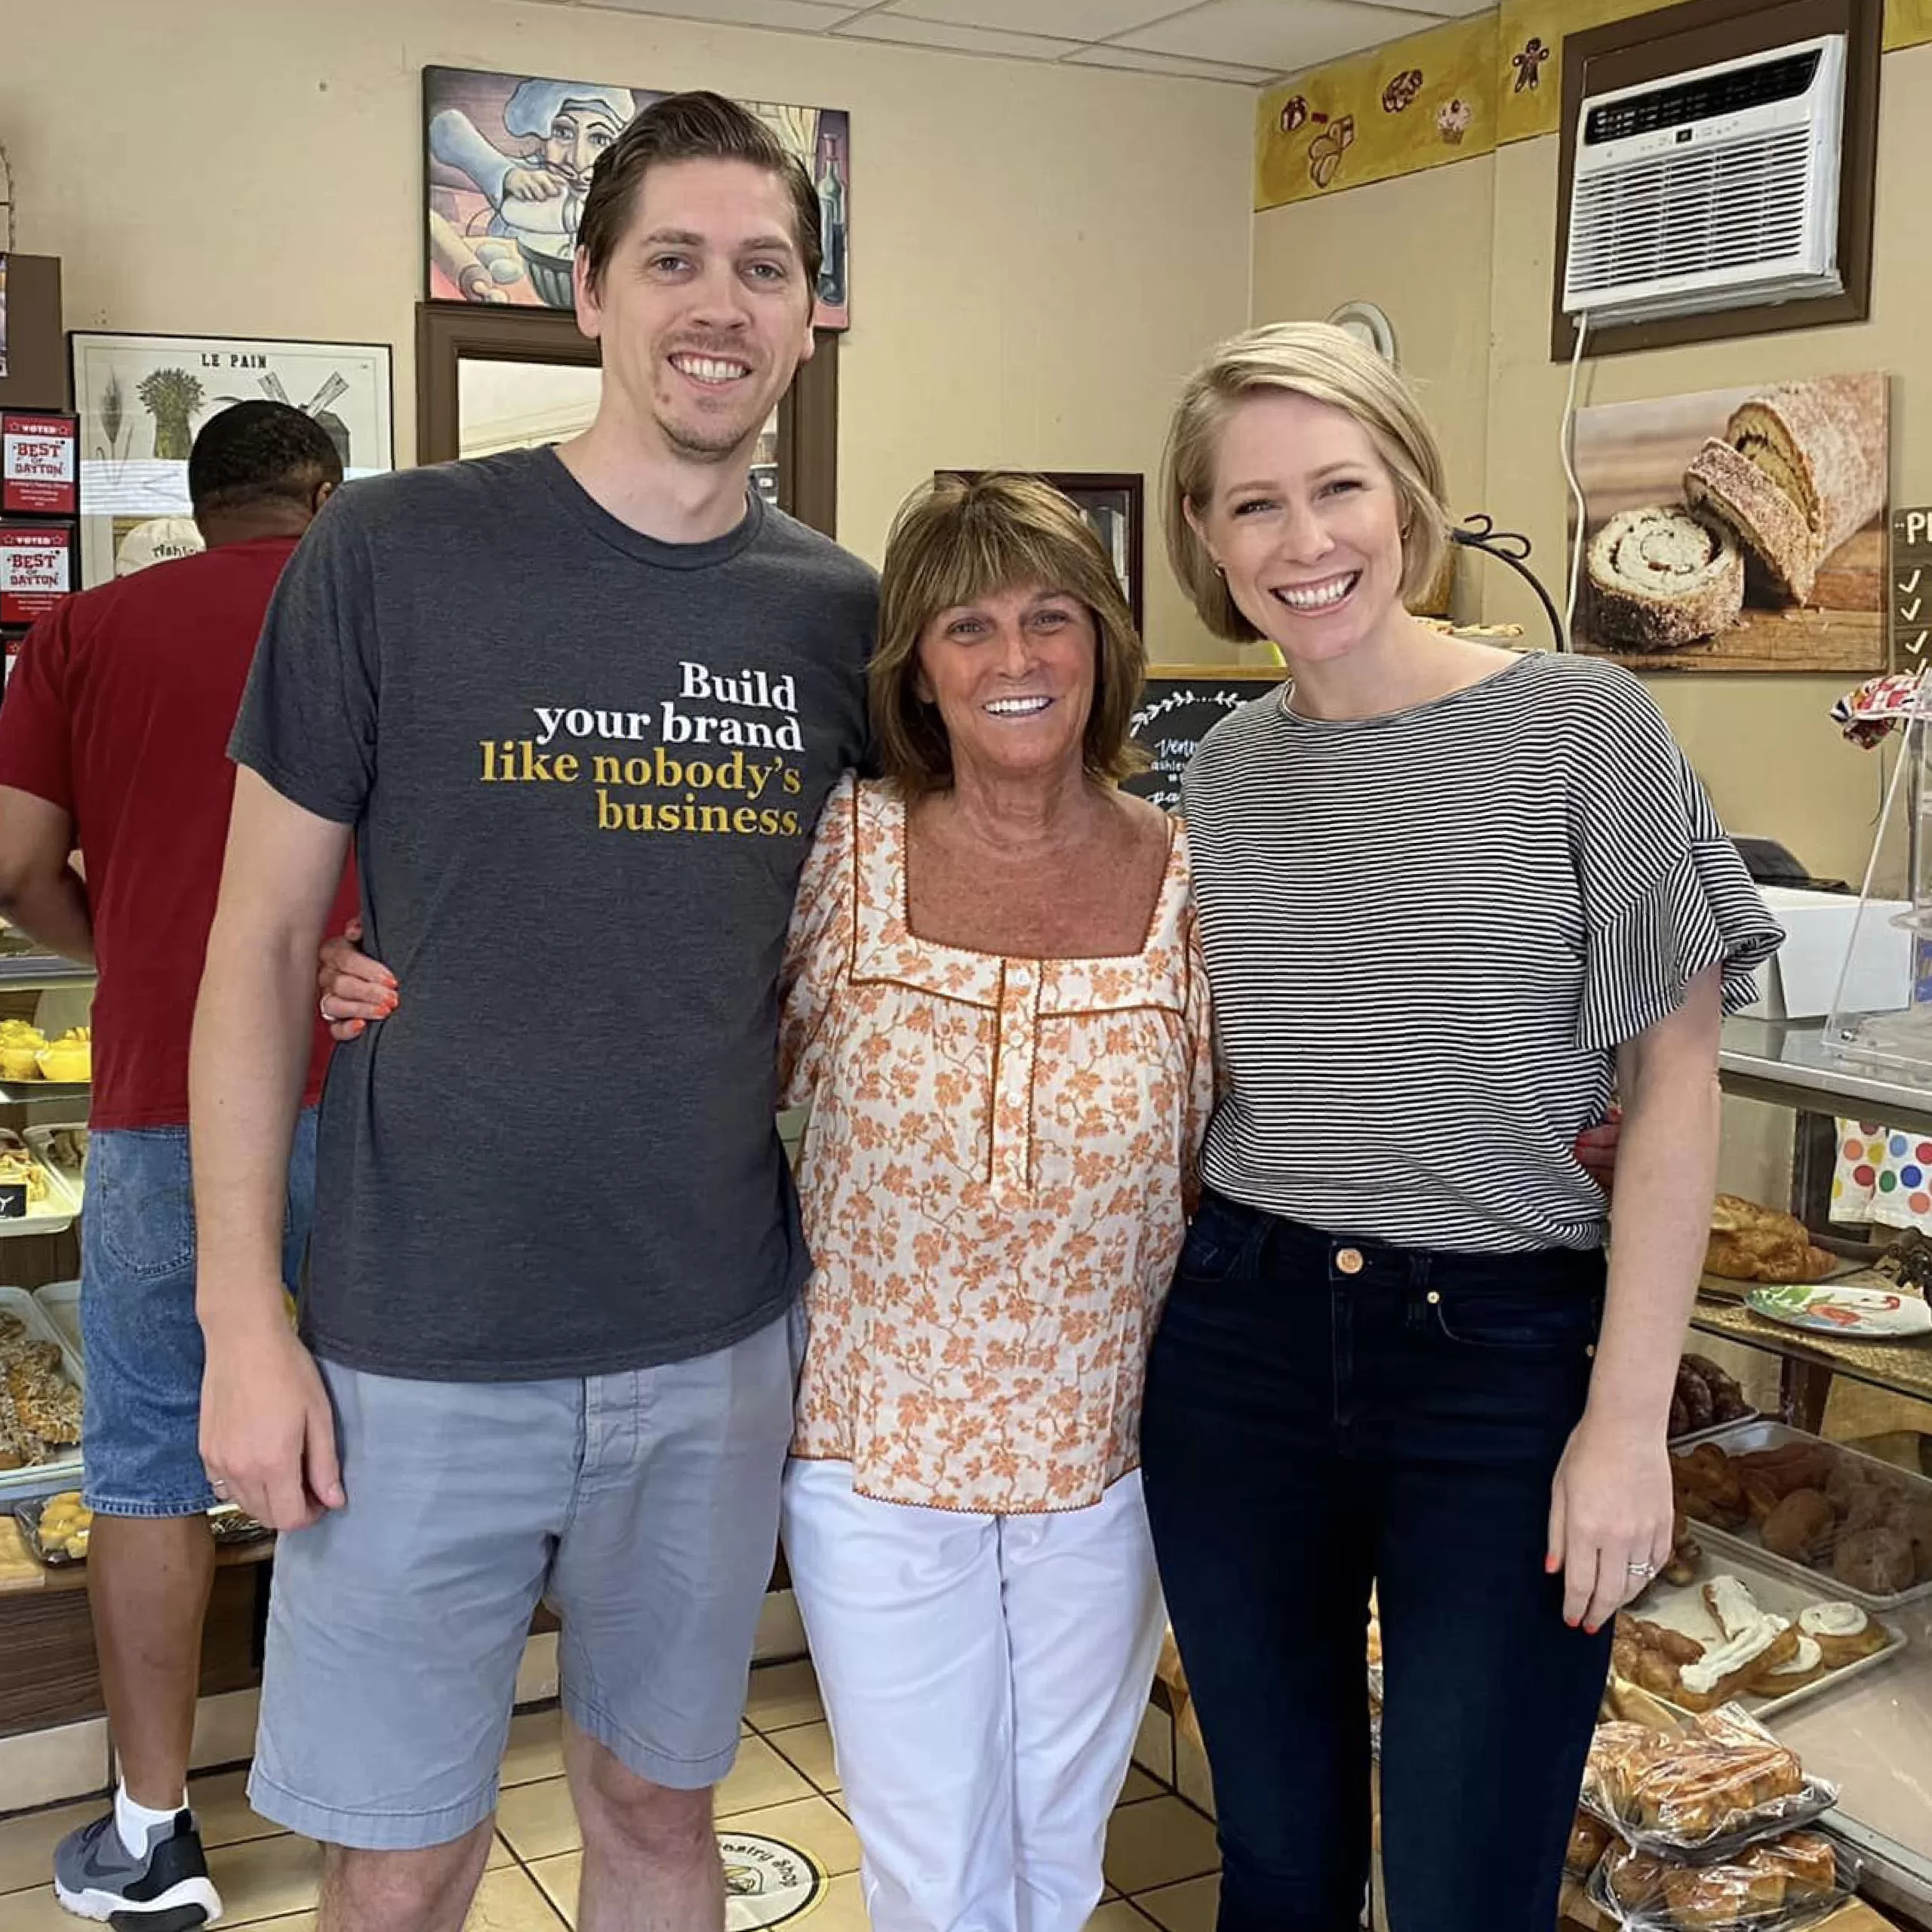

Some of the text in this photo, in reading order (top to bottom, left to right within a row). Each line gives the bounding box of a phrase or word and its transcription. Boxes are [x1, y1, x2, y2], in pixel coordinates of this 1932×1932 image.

[202, 353, 266, 368] LE PAIN
[15, 442, 62, 457] BEST
[15, 462, 64, 475] DAYTON
[11, 553, 57, 569] BEST
[11, 573, 59, 586] DAYTON
[678, 661, 798, 713] Build
[534, 701, 806, 752] your brand
[479, 740, 801, 800] like nobody's
[595, 789, 803, 836] business.
